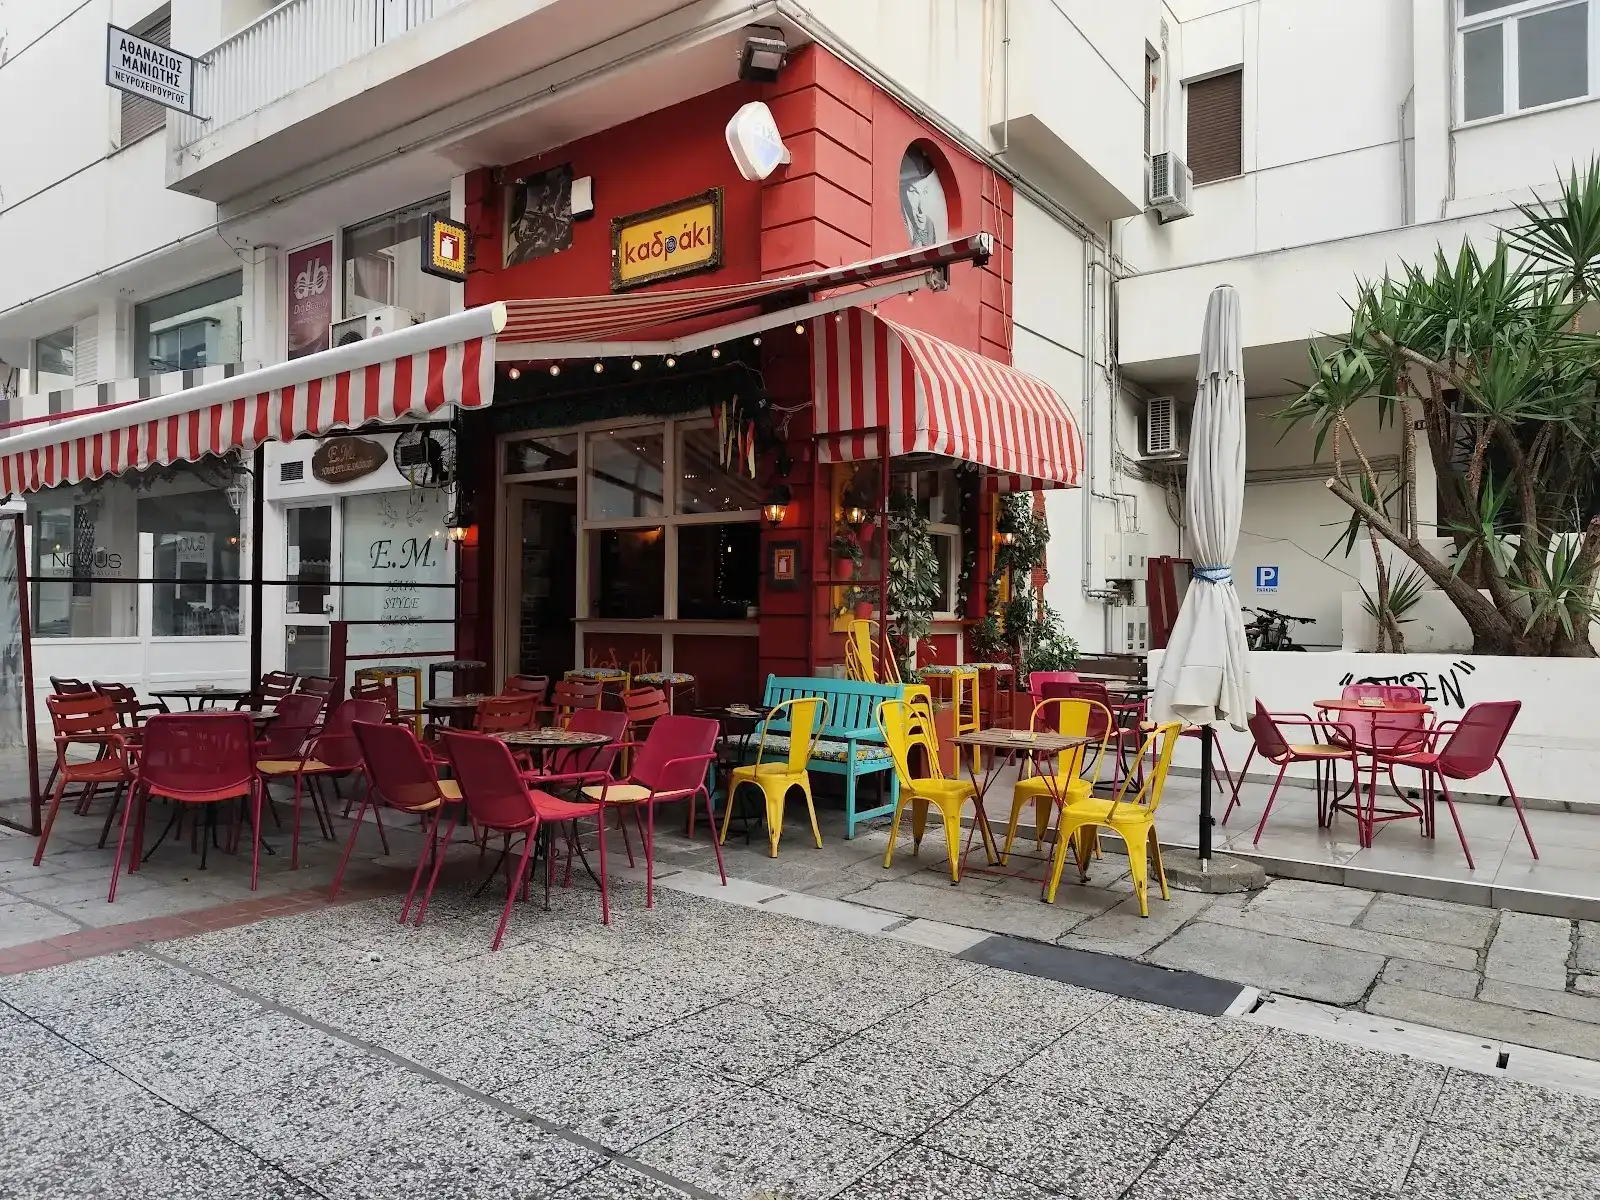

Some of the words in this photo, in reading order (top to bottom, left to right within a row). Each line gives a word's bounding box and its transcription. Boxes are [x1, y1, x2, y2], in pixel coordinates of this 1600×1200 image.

[120, 38, 183, 74] ΑΘΑΝΑΣΙΟΣ
[122, 53, 180, 88] ΜΑΝΙΩΤΗΣ
[115, 70, 185, 105] ΝΕΥΡΟΧΕΙΡΟΥΡΓΟΣ
[370, 537, 436, 569] E.M.
[383, 596, 420, 610] STYLE
